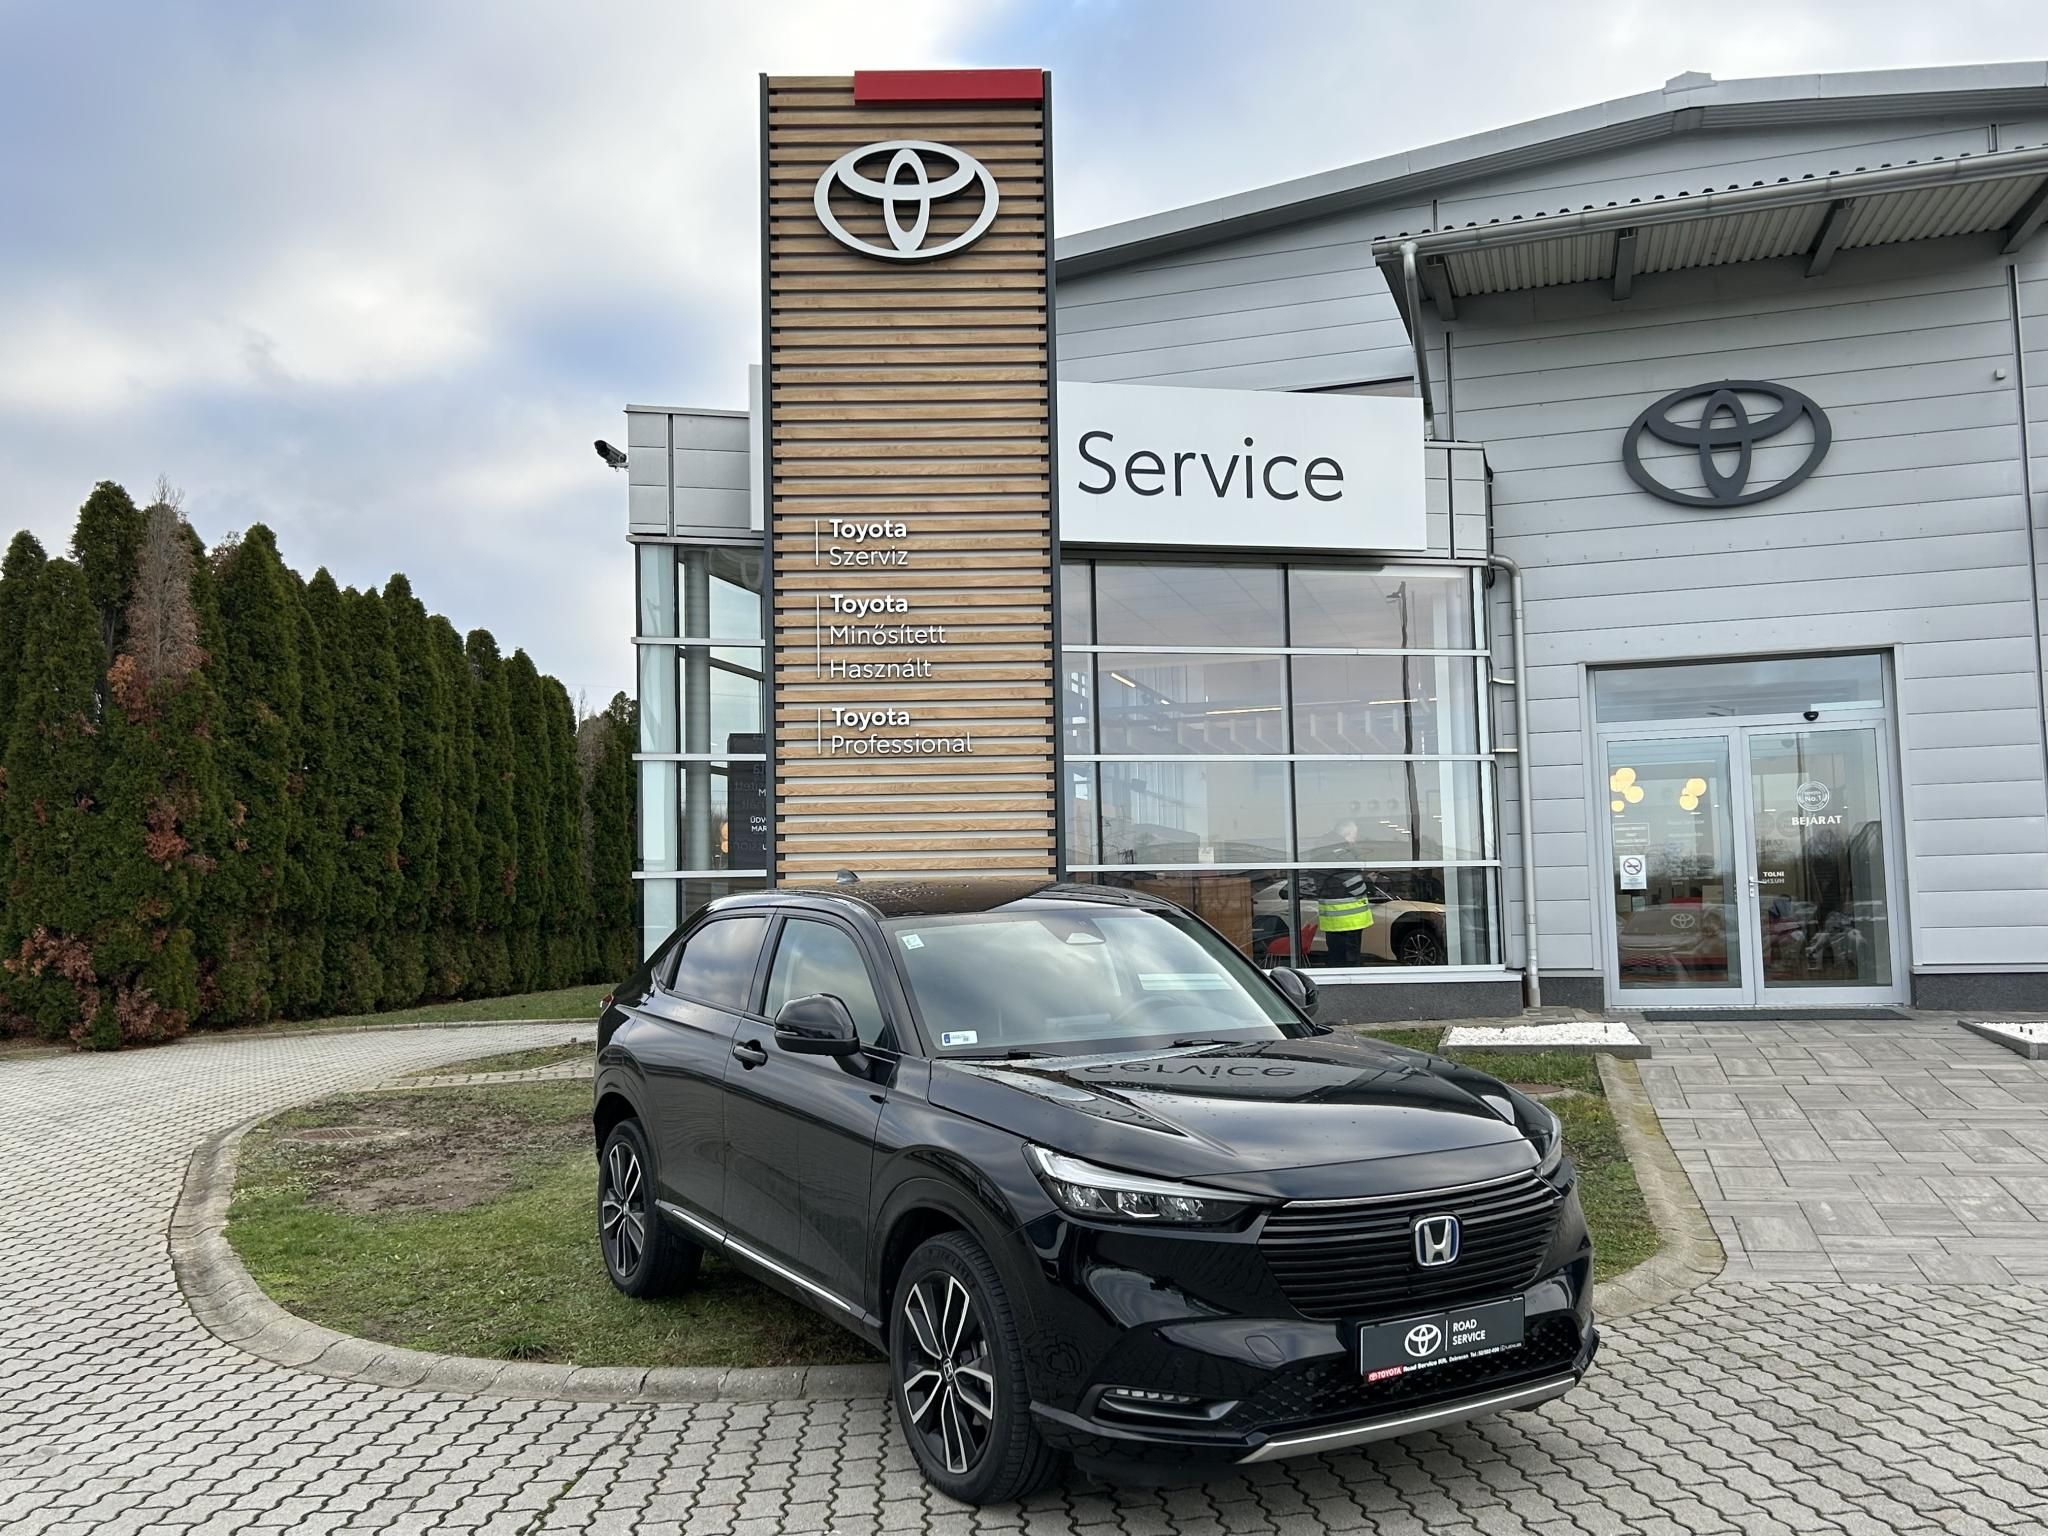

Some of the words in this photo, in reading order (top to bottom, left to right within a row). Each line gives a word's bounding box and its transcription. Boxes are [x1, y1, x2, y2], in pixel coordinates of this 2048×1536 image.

[1078, 430, 1344, 502] Service
[829, 518, 907, 543] Toyota
[829, 545, 909, 566] Szerviz
[829, 594, 909, 618] Toyota
[830, 624, 947, 645] Minősített
[830, 657, 932, 678] Használt
[831, 707, 910, 731] Toyota
[831, 732, 973, 754] Professional
[1791, 814, 1843, 827] BEJÁRAT
[1453, 1319, 1477, 1332] ROAD
[1452, 1330, 1486, 1345] SERVICE
[1377, 1366, 1403, 1379] TOYOTA
